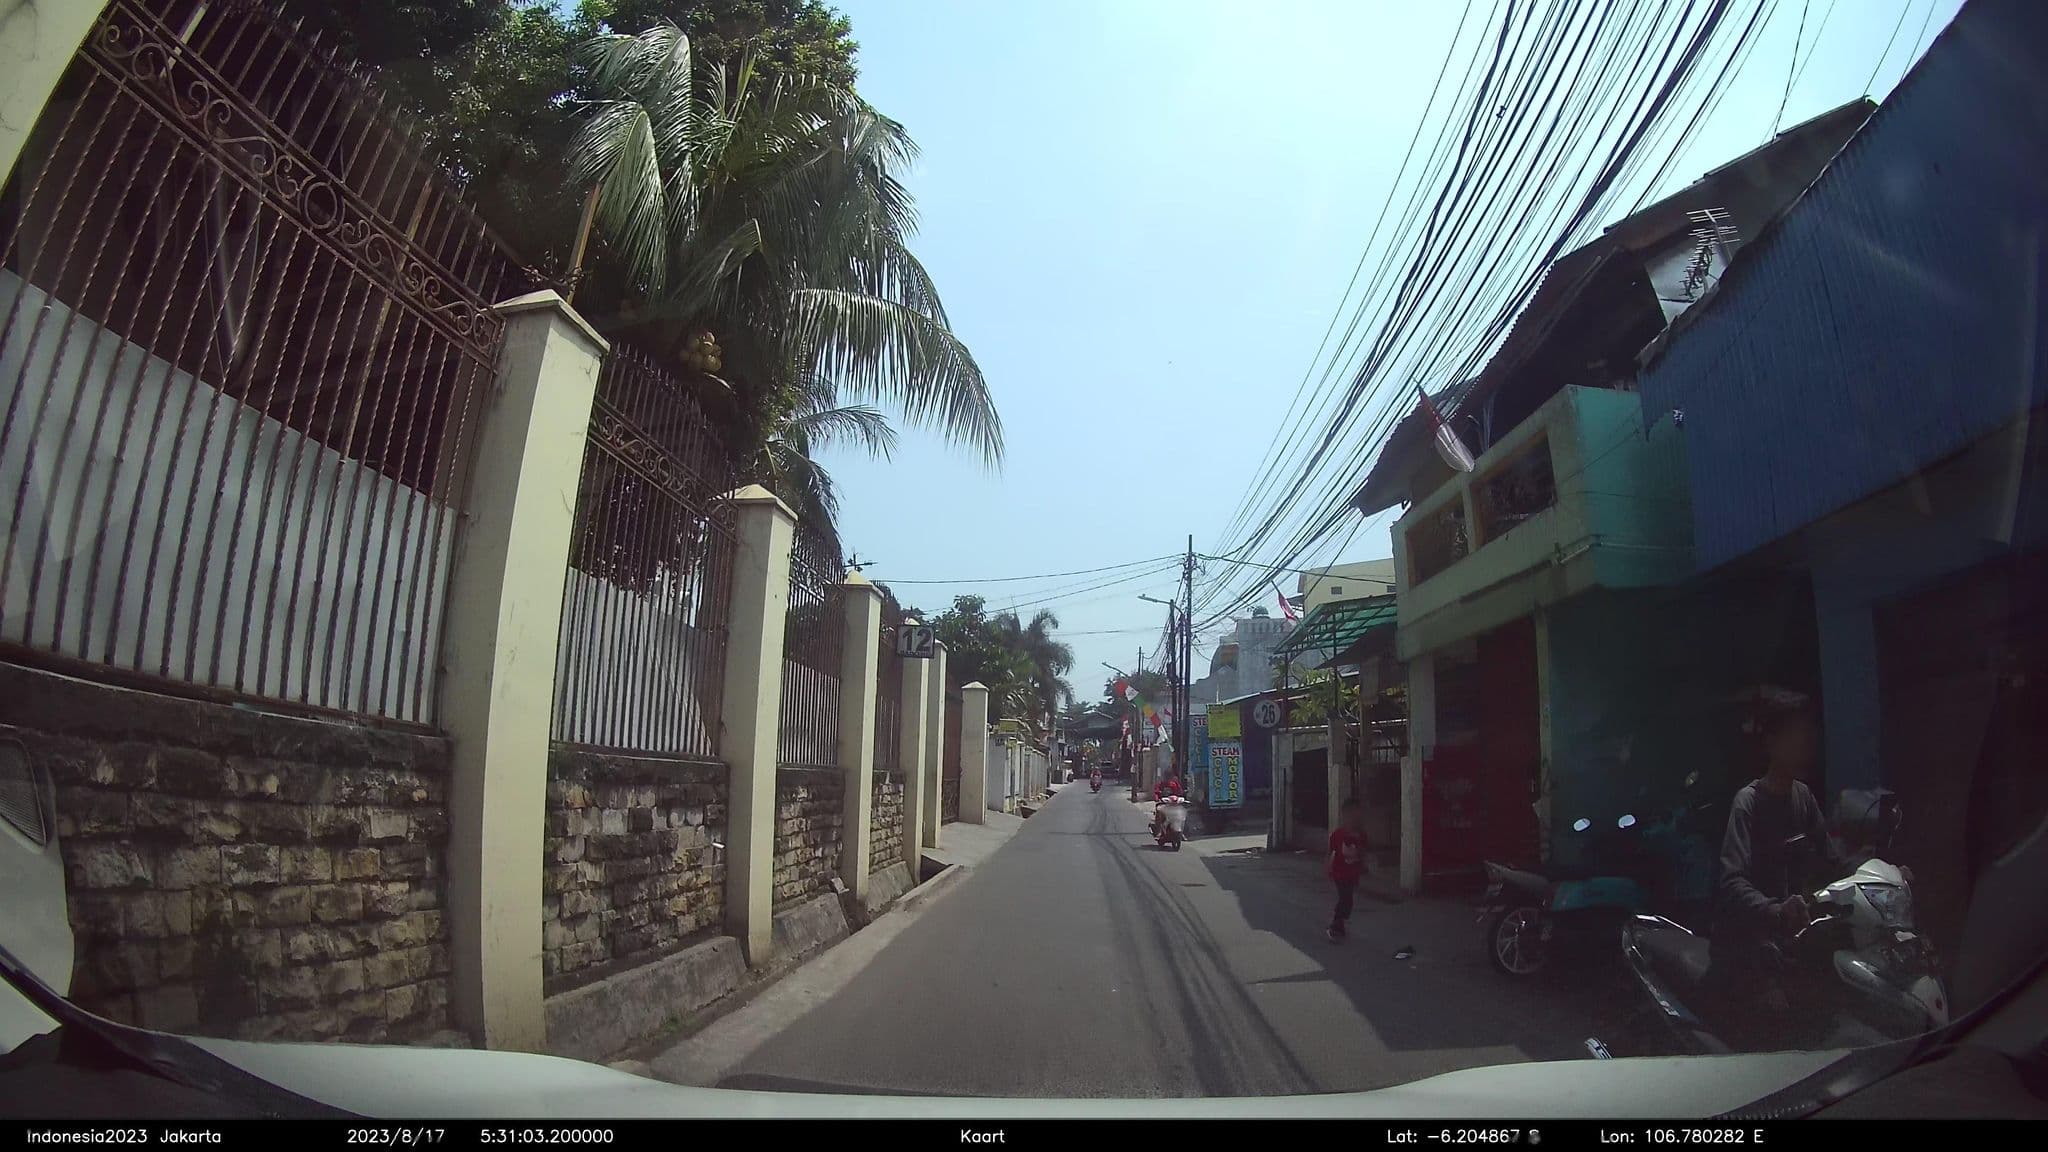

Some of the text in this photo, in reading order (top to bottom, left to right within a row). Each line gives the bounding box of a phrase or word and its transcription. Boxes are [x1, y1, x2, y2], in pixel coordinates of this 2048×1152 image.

[903, 628, 931, 652] 12
[1261, 704, 1276, 725] 26
[1212, 747, 1240, 756] STEAM
[1227, 757, 1238, 799] MOTOR
